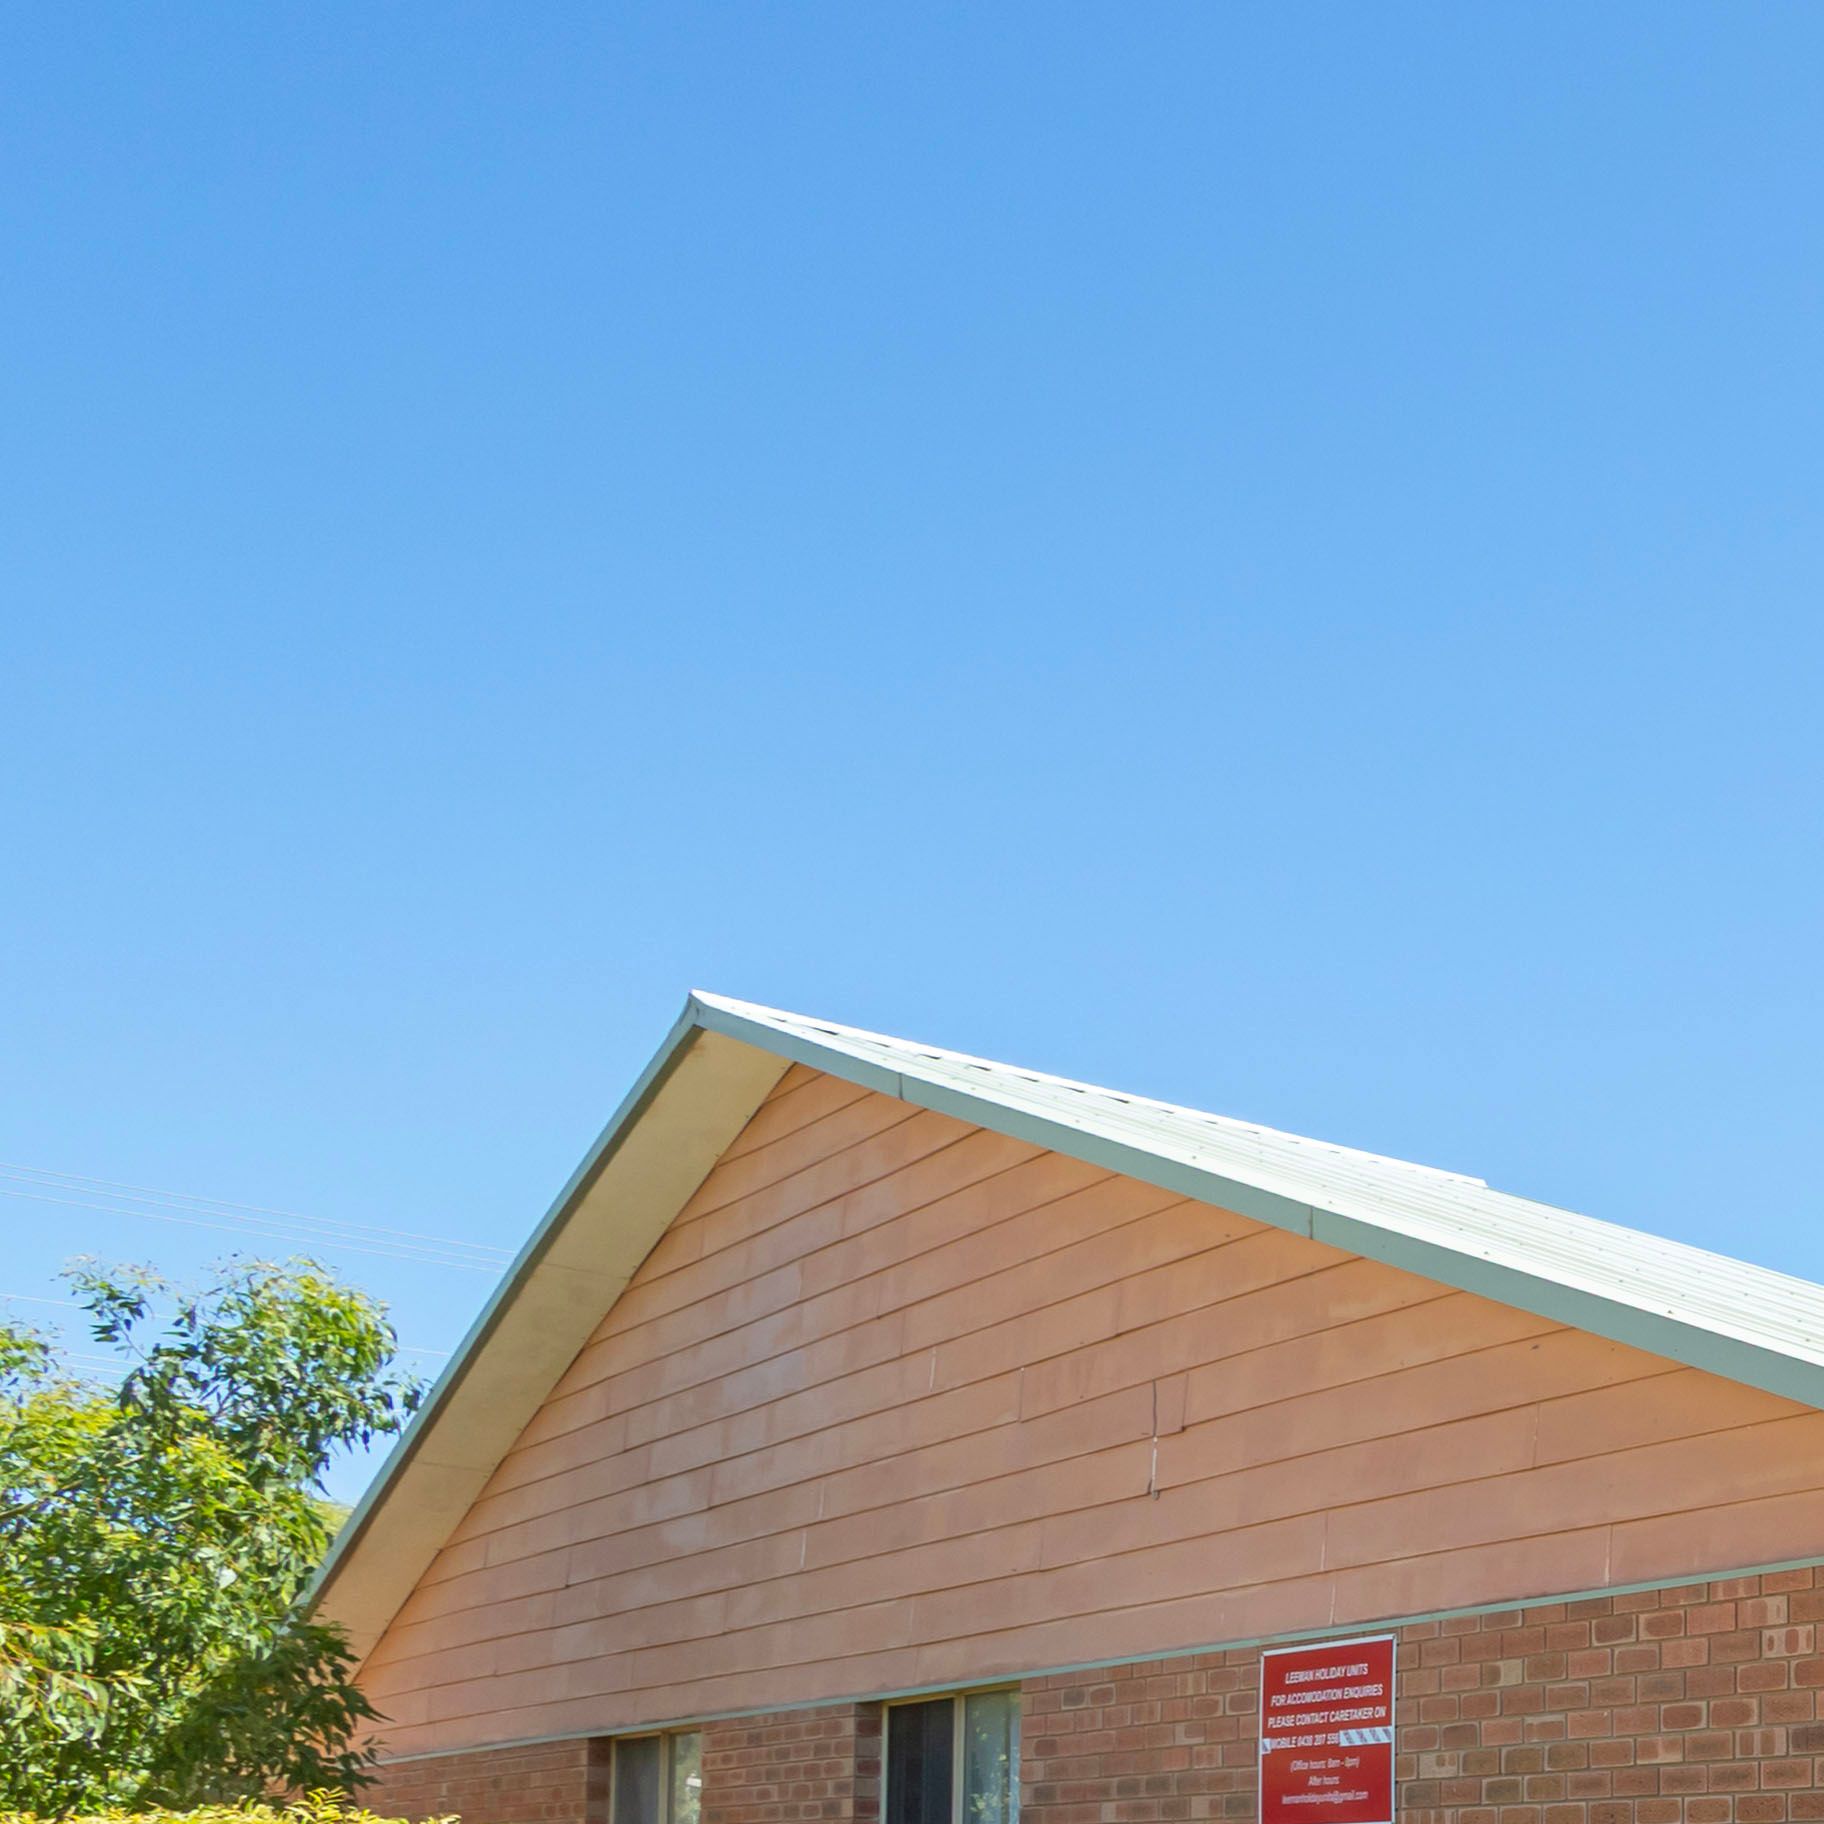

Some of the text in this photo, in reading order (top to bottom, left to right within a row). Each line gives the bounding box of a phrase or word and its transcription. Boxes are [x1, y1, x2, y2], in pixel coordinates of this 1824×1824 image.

[1315, 1665, 1346, 1680] HOLIDAY
[1346, 1663, 1369, 1677] UNITS
[1270, 1694, 1286, 1707] FOR
[1343, 1683, 1384, 1699] ENQUIRIES
[1267, 1706, 1387, 1728] PLEASE CONTACT CARETAKER ON
